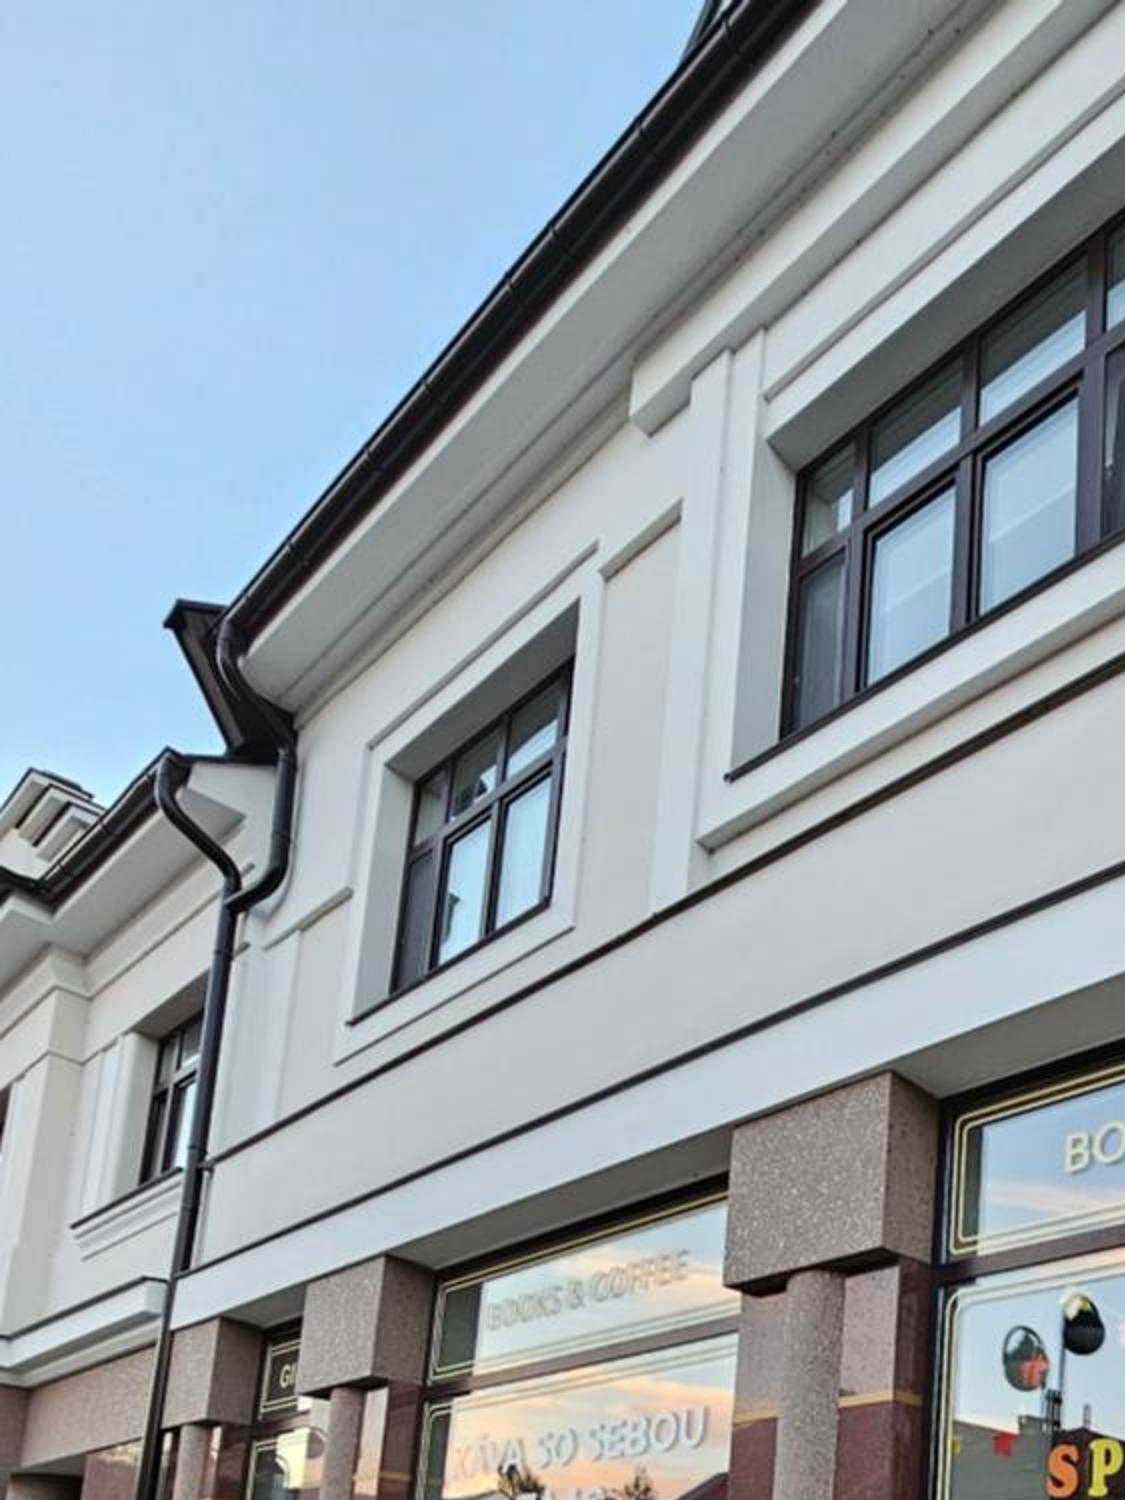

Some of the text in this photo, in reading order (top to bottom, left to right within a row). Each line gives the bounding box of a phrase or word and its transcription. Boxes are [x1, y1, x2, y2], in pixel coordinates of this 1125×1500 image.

[486, 1287, 563, 1331] BOOKS
[591, 1249, 690, 1303] COFFEE
[588, 1406, 710, 1462] SEBOU
